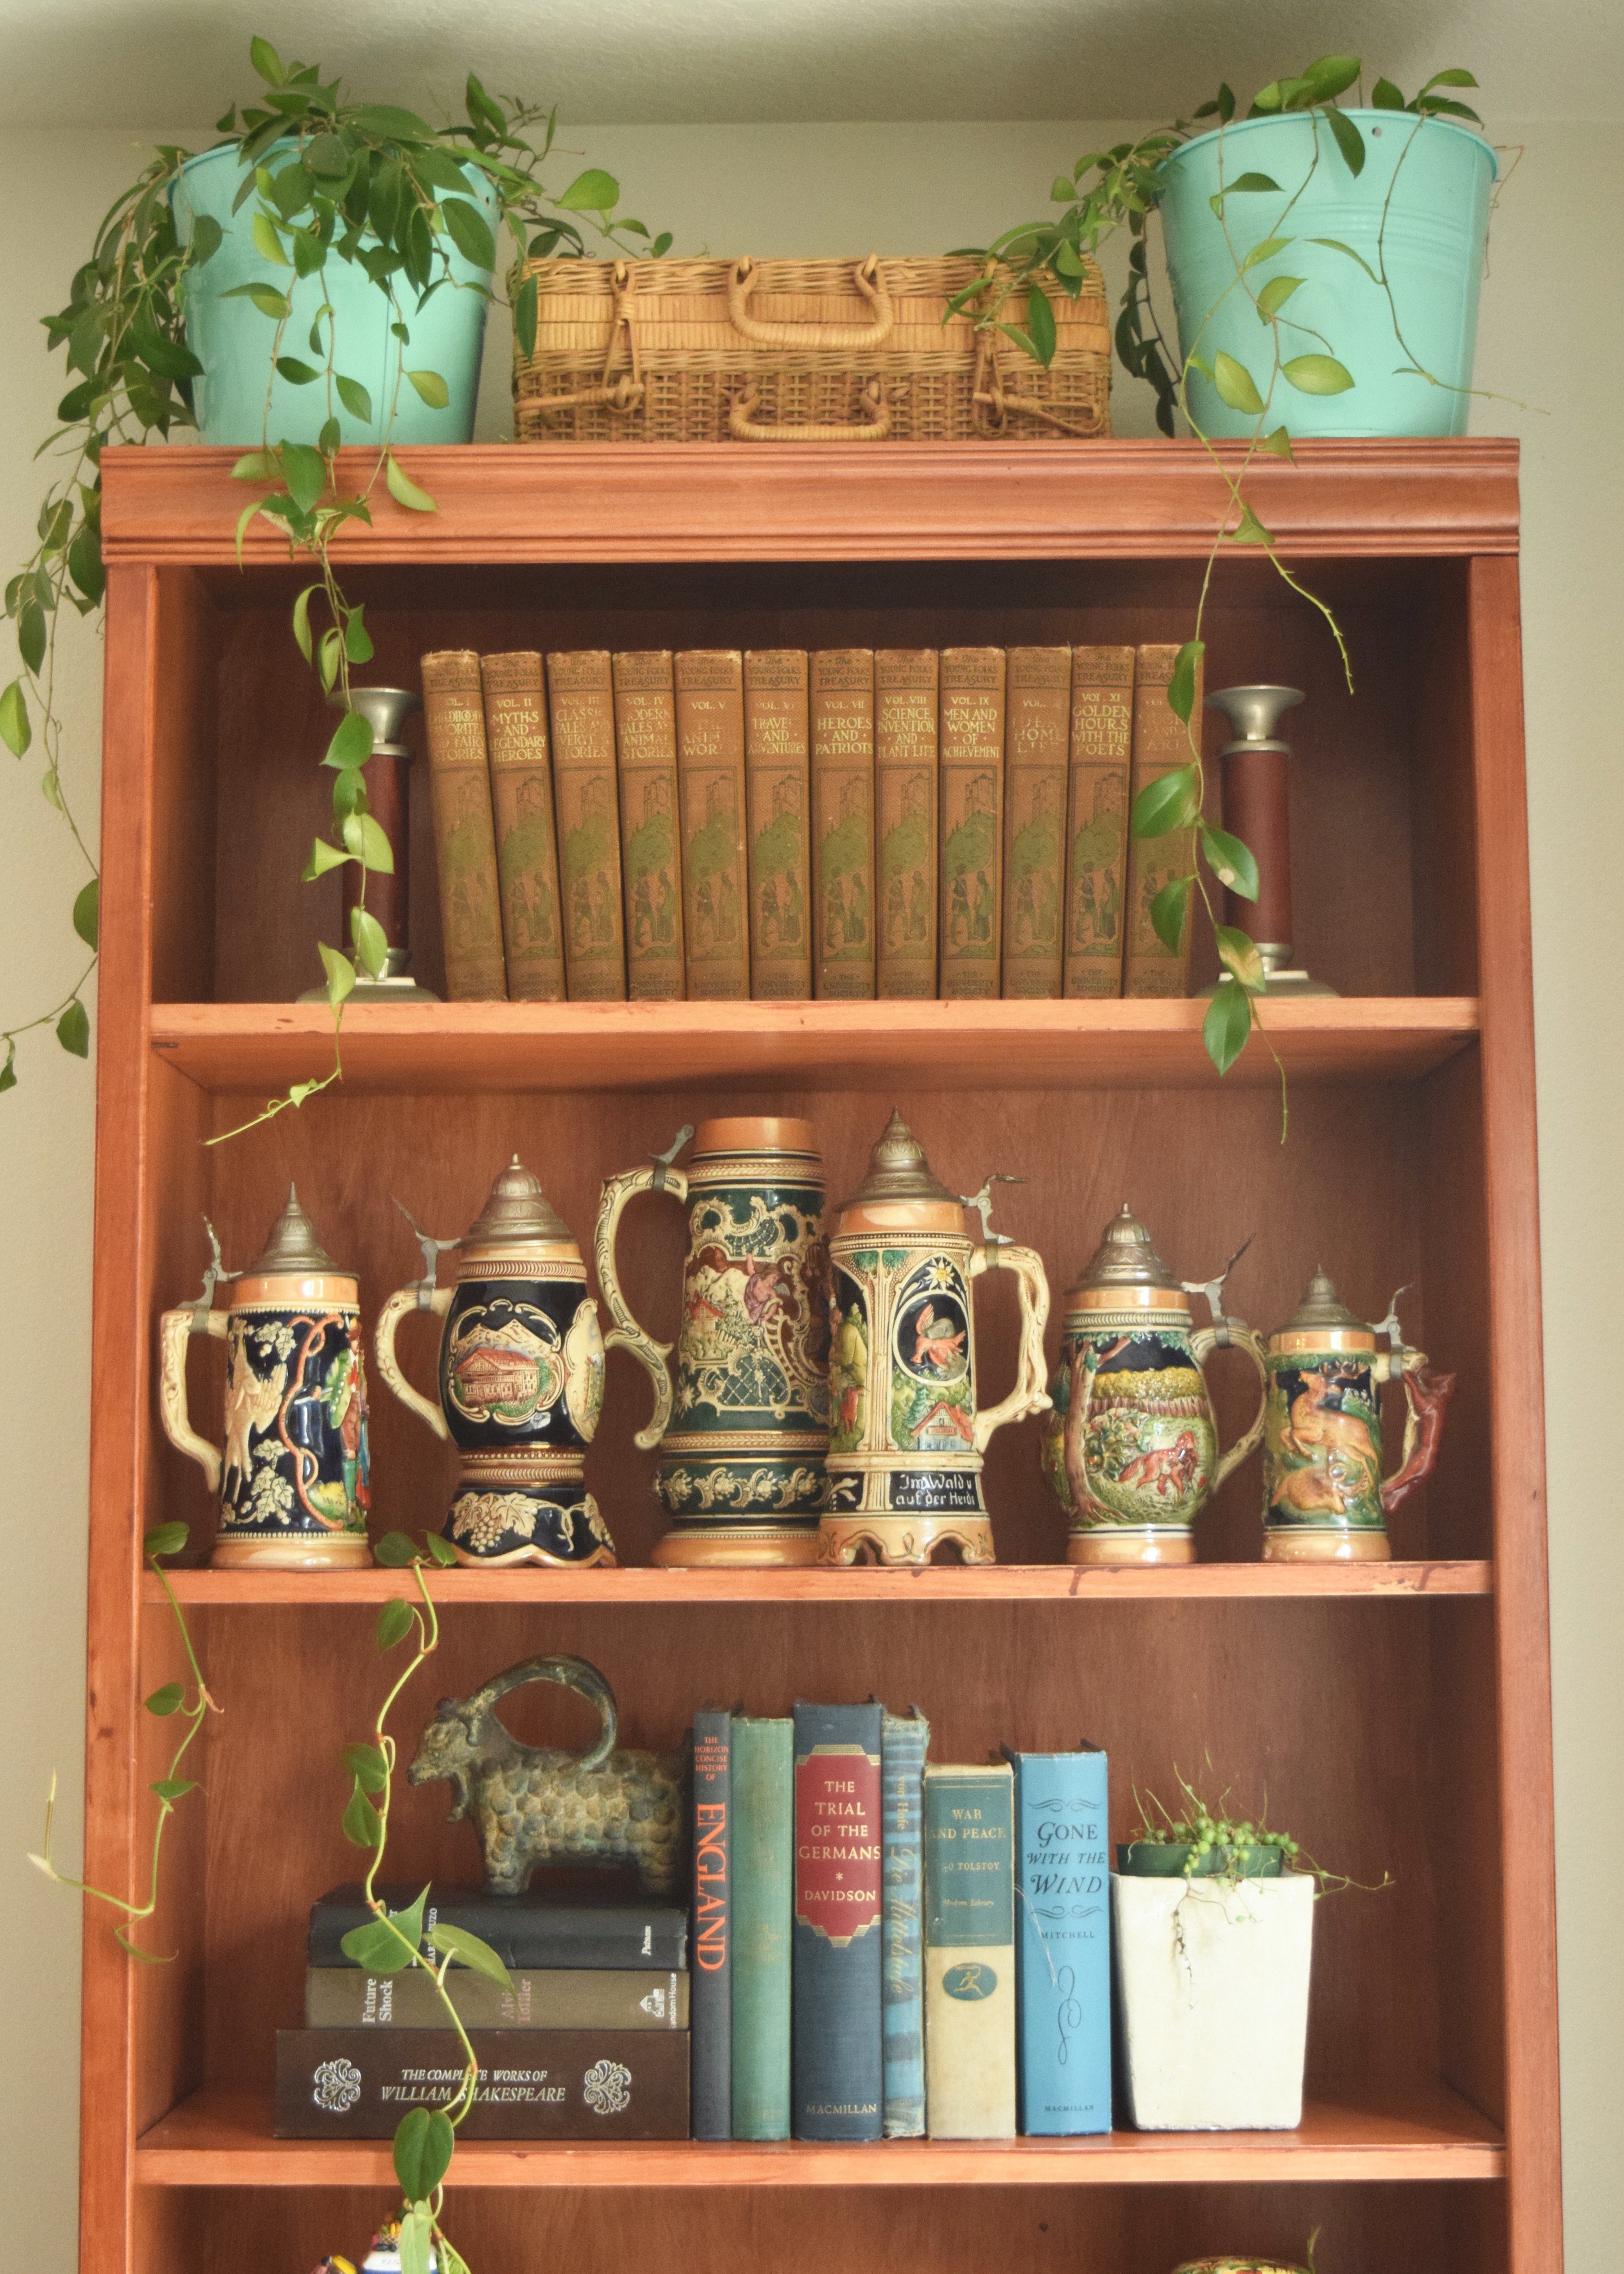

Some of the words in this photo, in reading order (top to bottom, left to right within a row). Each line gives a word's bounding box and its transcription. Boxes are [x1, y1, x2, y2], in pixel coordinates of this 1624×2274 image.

[681, 676, 733, 688] TREASURY
[748, 676, 801, 688] TREASURY
[818, 677, 870, 688] TREASURY
[879, 674, 932, 687] TREASURY
[944, 674, 997, 686] TREASURY
[1076, 672, 1129, 684] TREASURY
[496, 699, 521, 708] VOL.
[524, 698, 532, 707] II
[653, 696, 664, 705] IV
[885, 696, 908, 705] VOL.
[909, 696, 927, 705] VIII
[950, 696, 976, 706] VOL.
[979, 696, 990, 706] IX
[1022, 699, 1047, 708] VOL.
[1110, 693, 1121, 702] XI
[691, 701, 716, 710] VOL.
[825, 701, 849, 710] VOL.
[851, 700, 865, 709] VII
[493, 711, 539, 725] MYTHS
[944, 709, 969, 722] MEN
[971, 708, 998, 721] AND
[1072, 705, 1131, 719] GOLDEN
[502, 724, 529, 736] AND
[818, 717, 872, 730] HEROES
[947, 720, 996, 734] WOMEN
[1074, 717, 1128, 731] HOURS
[763, 729, 790, 742] AND
[831, 730, 859, 743] AND
[896, 732, 918, 745] AND
[962, 733, 978, 746] OF
[1072, 730, 1104, 744] WITH
[1106, 730, 1130, 744] THE
[493, 748, 543, 762] HEROES
[815, 742, 873, 756] PATRIOTS
[878, 746, 910, 759] PLANT
[912, 745, 936, 758] LIFE
[944, 746, 1000, 759] ACHIEVEMENT
[1076, 743, 1125, 756] POETS
[927, 1473, 964, 1489] Wald
[895, 1490, 924, 1505] auf
[925, 1489, 946, 1506] der
[705, 1773, 716, 1781] OF
[824, 1781, 855, 1793] THE
[814, 1802, 866, 1816] TRIAL
[951, 1808, 982, 1820] WAR
[811, 1824, 831, 1837] OF
[838, 1824, 869, 1837] THE
[962, 1827, 1007, 1839] PEACE
[1037, 1821, 1098, 1848] GONE
[799, 1846, 881, 1860] GERMANS
[1027, 1852, 1070, 1865] WITH
[1077, 1852, 1106, 1864] THE
[957, 1861, 1000, 1871] TOLSTOY
[696, 1802, 726, 1970] ENGLAND
[1030, 1873, 1102, 1895] WIND
[804, 1890, 876, 1902] DAVIDSON
[943, 1899, 968, 1907] Modern
[1041, 1931, 1095, 1939] MITCHELL
[668, 1972, 678, 1998] House
[363, 1978, 377, 2023] Future
[379, 1980, 393, 2021] Shock
[402, 2069, 426, 2080] THE
[493, 2069, 532, 2082] WORKS
[532, 2069, 548, 2082] OF
[381, 2086, 452, 2101] WILLIAM
[806, 2103, 877, 2114] MACMILLAN
